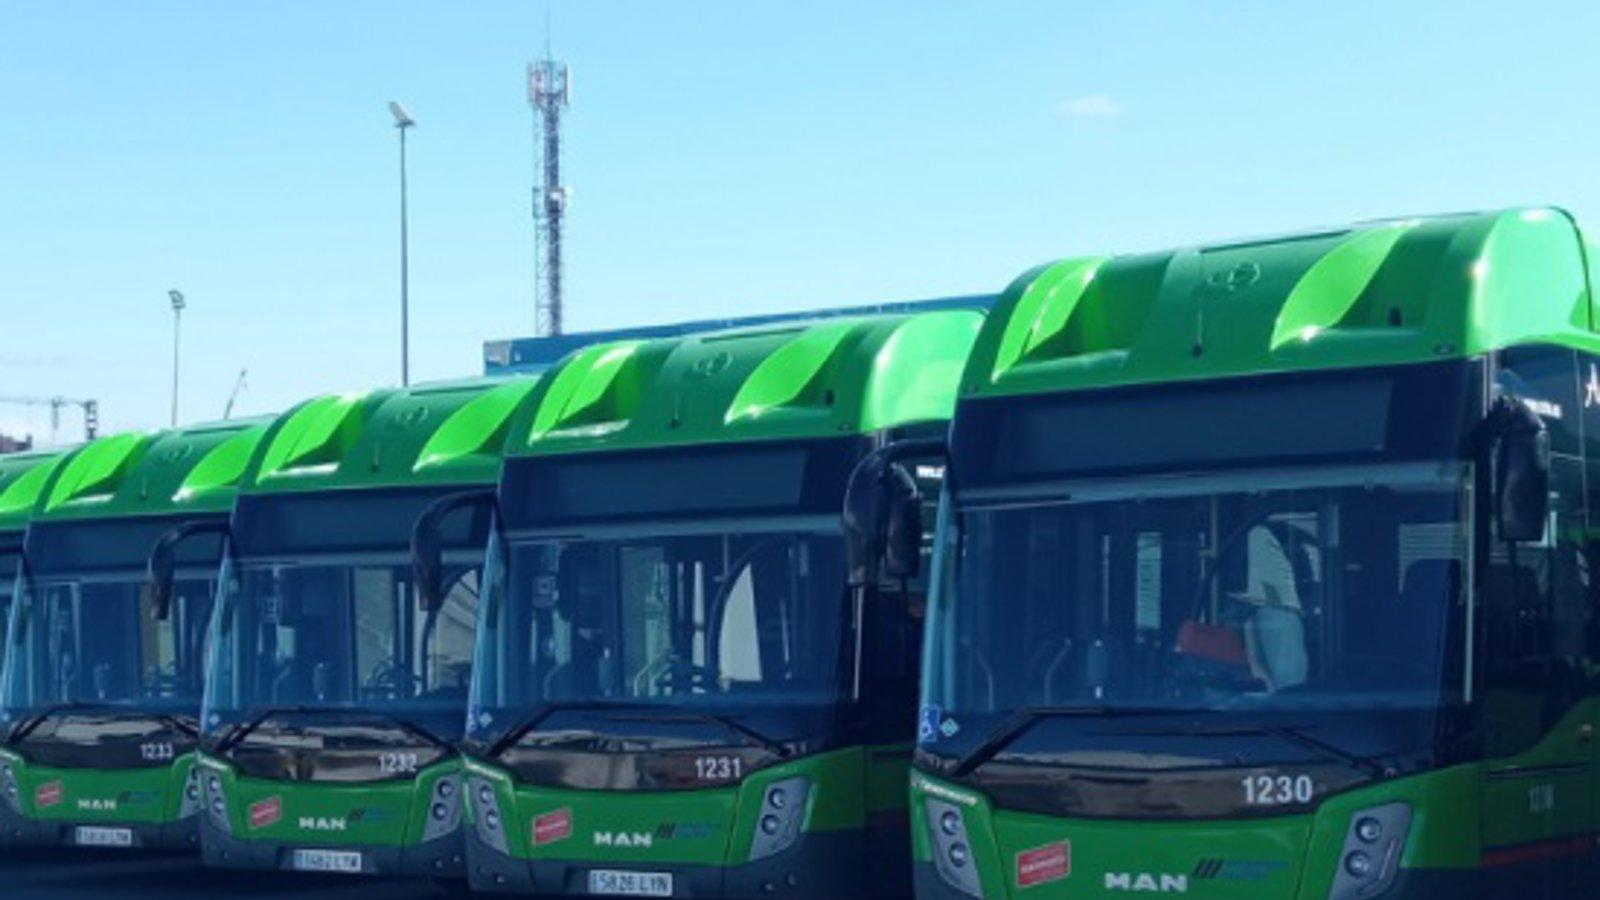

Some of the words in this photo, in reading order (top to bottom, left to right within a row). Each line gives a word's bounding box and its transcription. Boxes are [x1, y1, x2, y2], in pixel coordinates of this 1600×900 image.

[141, 744, 173, 759] 1233
[378, 753, 417, 772] 1232
[695, 757, 741, 778] 1231
[1242, 775, 1313, 804] 1230
[78, 798, 117, 810] MAN
[299, 817, 346, 830] MAN
[594, 831, 652, 846] MAN
[1104, 872, 1188, 892] MAN
